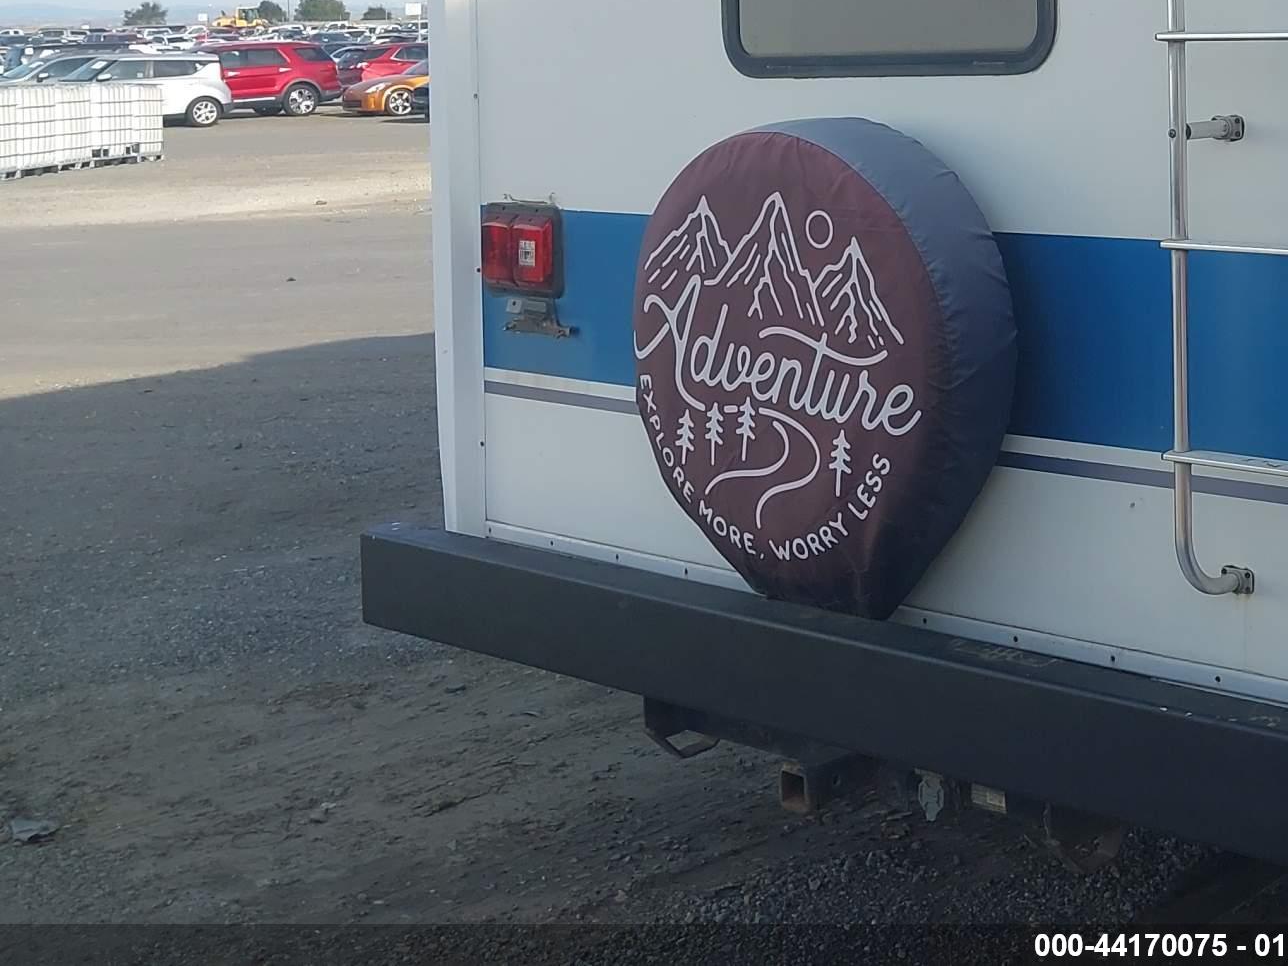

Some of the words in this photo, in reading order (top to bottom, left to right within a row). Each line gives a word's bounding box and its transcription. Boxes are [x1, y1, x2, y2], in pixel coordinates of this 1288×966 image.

[633, 275, 922, 436] Adventure
[639, 374, 694, 502] EXPLORE
[699, 498, 765, 560] MORE,
[769, 513, 849, 562] WORRY
[848, 453, 892, 521] LESS
